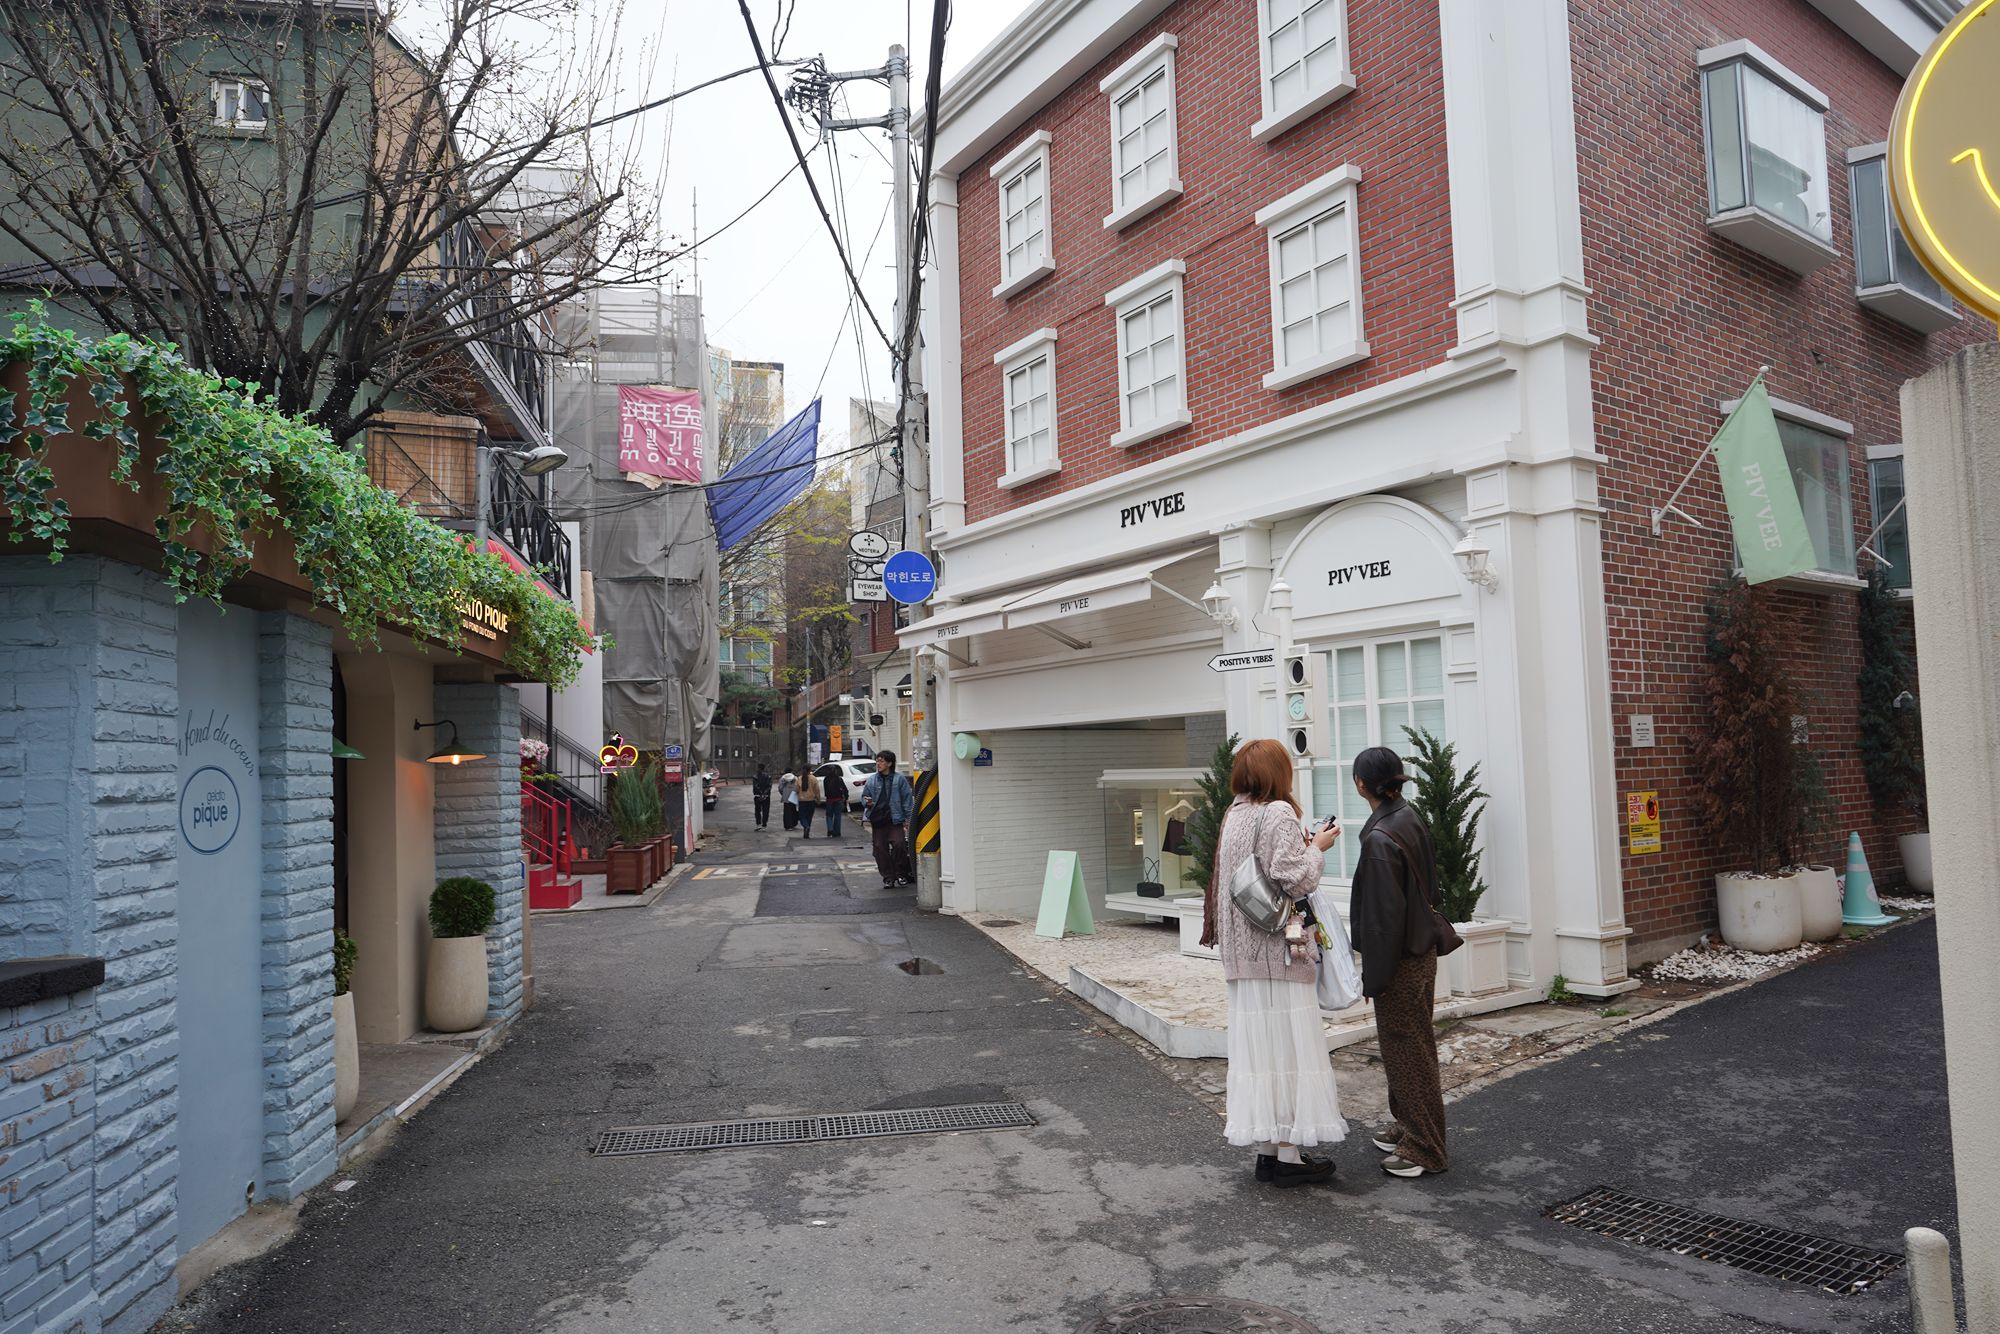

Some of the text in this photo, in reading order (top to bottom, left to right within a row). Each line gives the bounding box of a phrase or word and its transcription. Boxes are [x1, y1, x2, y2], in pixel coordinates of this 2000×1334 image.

[1120, 491, 1186, 528] PIV'VEE
[886, 571, 932, 583] 막힌도로
[1328, 559, 1391, 586] PIV'VEE
[484, 604, 509, 633] PIQUE
[1219, 654, 1273, 667] POSITIVE VIBES
[185, 709, 214, 756] fond
[213, 714, 230, 746] du
[206, 790, 226, 805] gelato
[193, 803, 229, 829] pique
